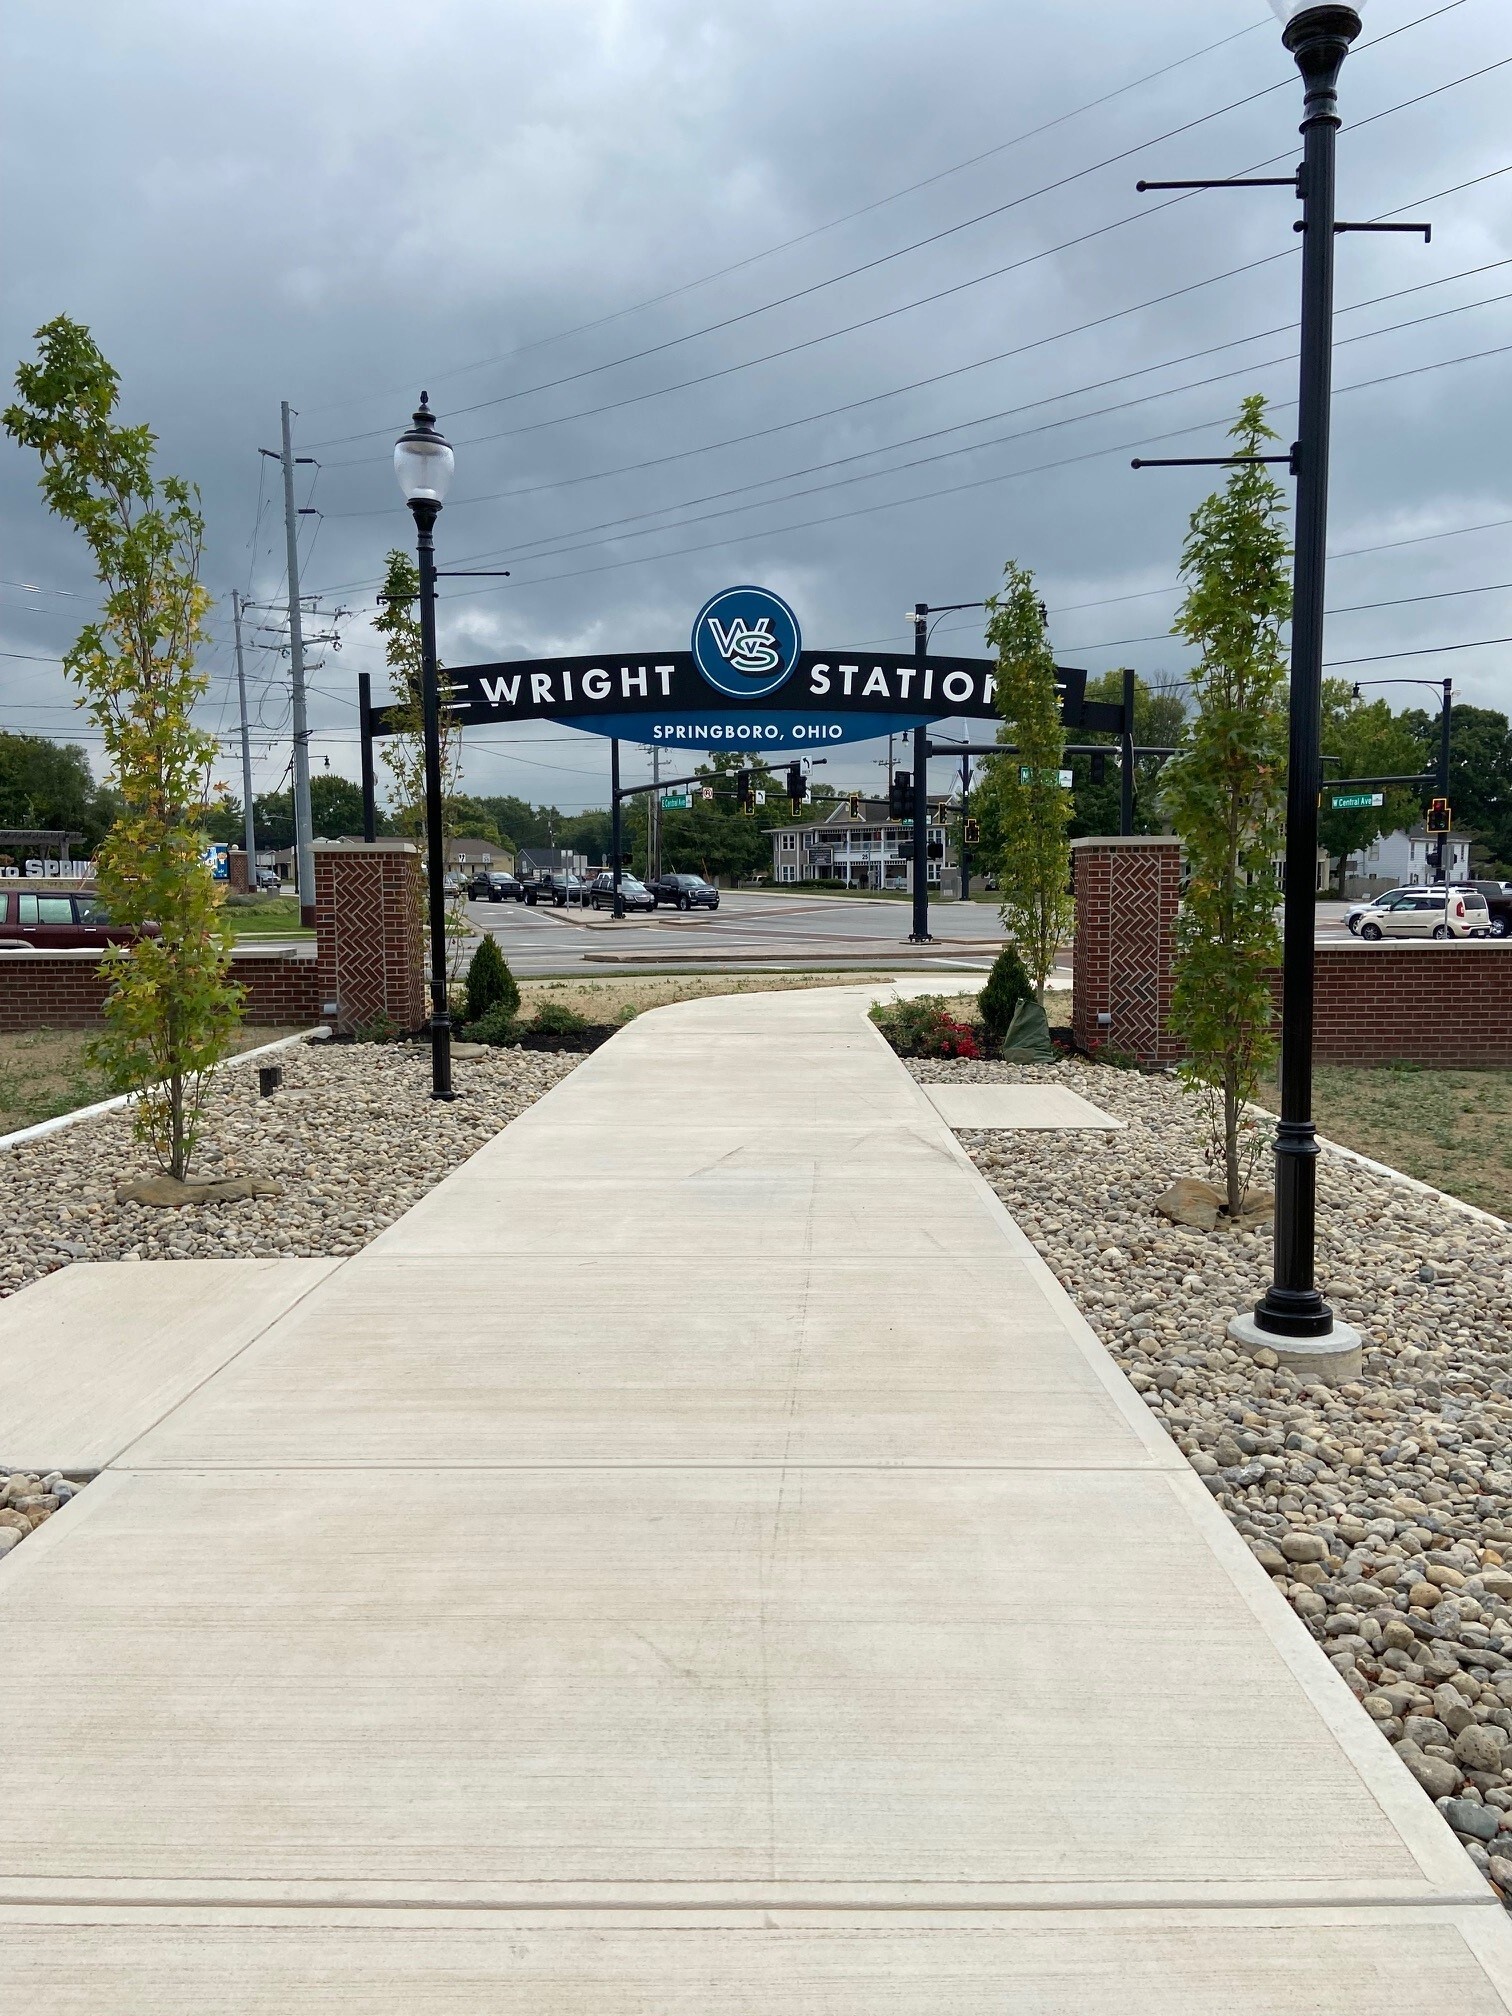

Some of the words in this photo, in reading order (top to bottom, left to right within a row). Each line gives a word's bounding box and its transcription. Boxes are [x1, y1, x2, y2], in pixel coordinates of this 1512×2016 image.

[479, 665, 675, 707] WRIGHT
[653, 725, 785, 741] SPRINGBORO,
[792, 725, 843, 739] OHIO
[1339, 798, 1359, 807] Central
[1361, 797, 1372, 805] Ave
